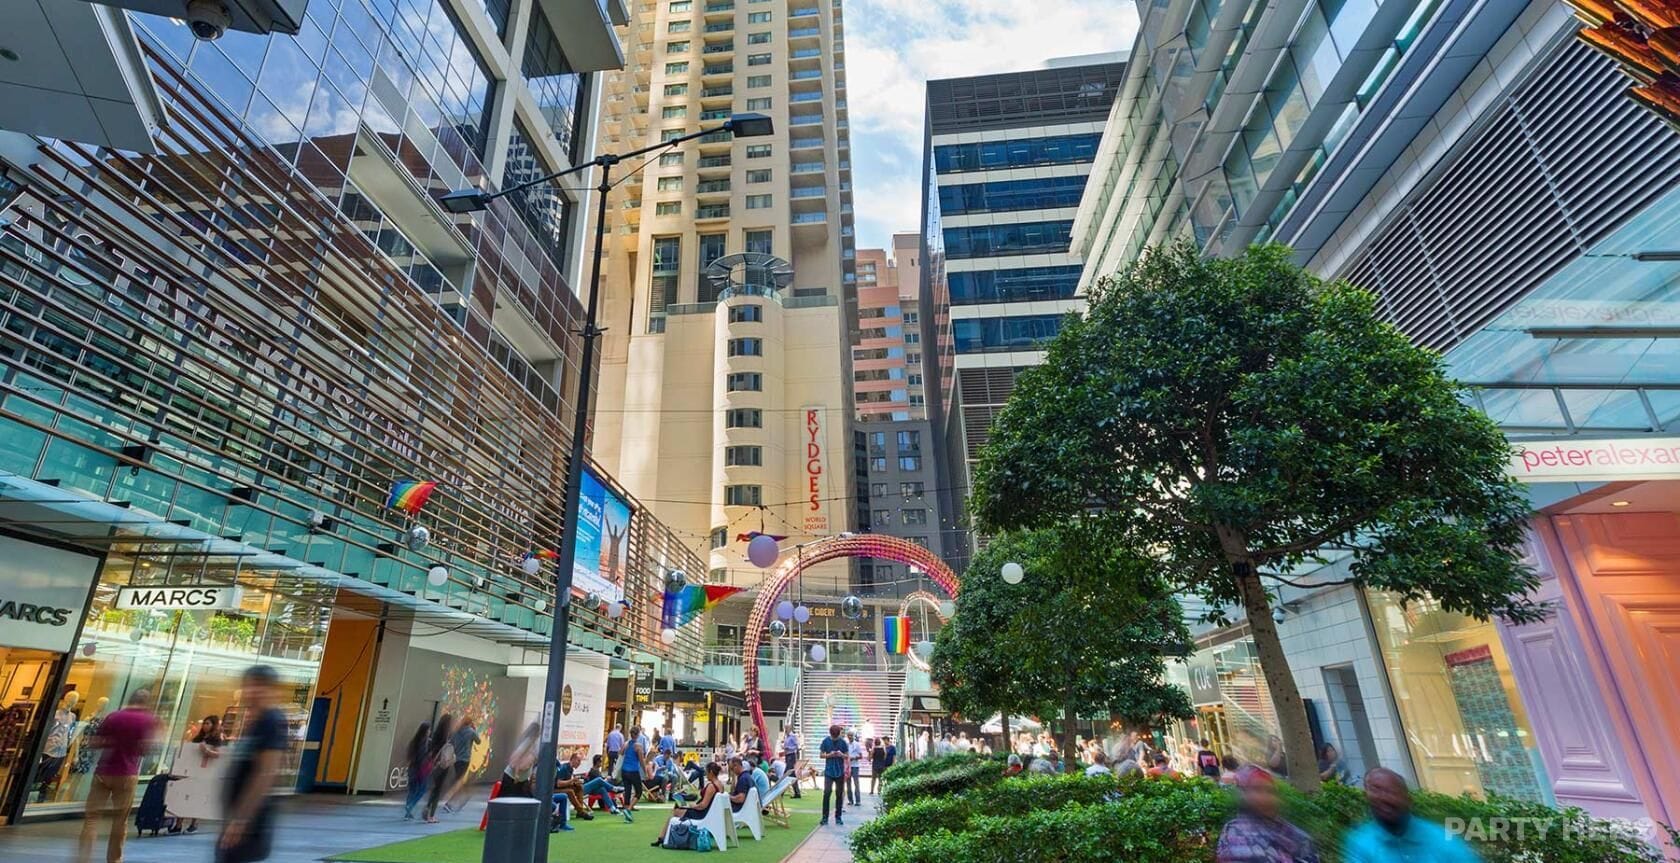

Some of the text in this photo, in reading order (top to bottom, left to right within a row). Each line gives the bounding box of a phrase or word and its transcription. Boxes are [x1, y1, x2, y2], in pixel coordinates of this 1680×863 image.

[807, 409, 821, 511] RYDGES
[804, 523, 827, 532] SQUARE
[130, 588, 217, 606] MARCS
[635, 687, 651, 695] FOOD
